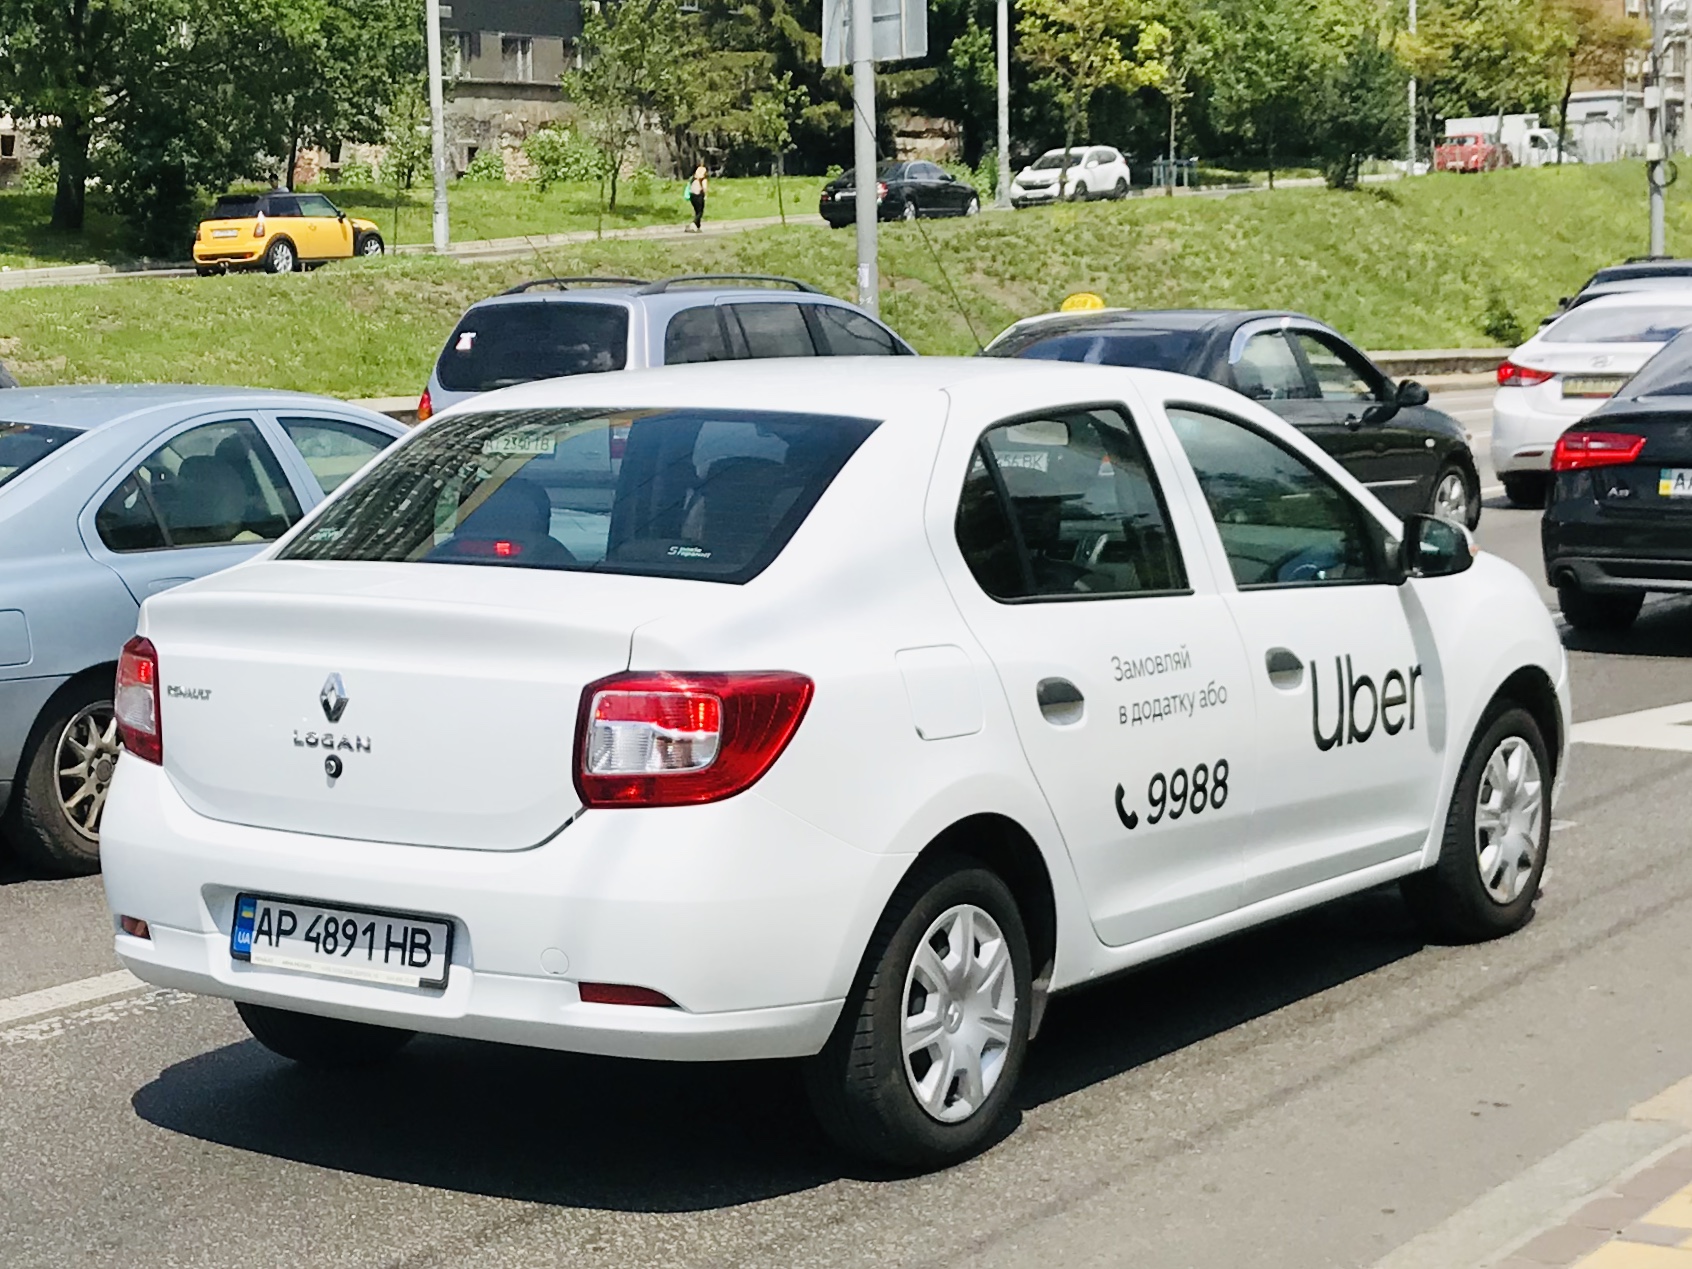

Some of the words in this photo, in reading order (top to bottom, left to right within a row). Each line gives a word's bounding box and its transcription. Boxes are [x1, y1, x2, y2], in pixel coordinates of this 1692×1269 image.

[1110, 644, 1192, 682] Замовляй
[1119, 705, 1128, 725] в
[1131, 690, 1196, 727] додатку
[1199, 680, 1228, 709] або
[1309, 653, 1422, 751] Uber
[293, 730, 372, 753] LOGAN
[1146, 758, 1229, 825] 9988
[237, 931, 250, 945] UA
[253, 907, 298, 948] AP
[304, 914, 376, 961] 4891
[384, 924, 432, 968] HB
